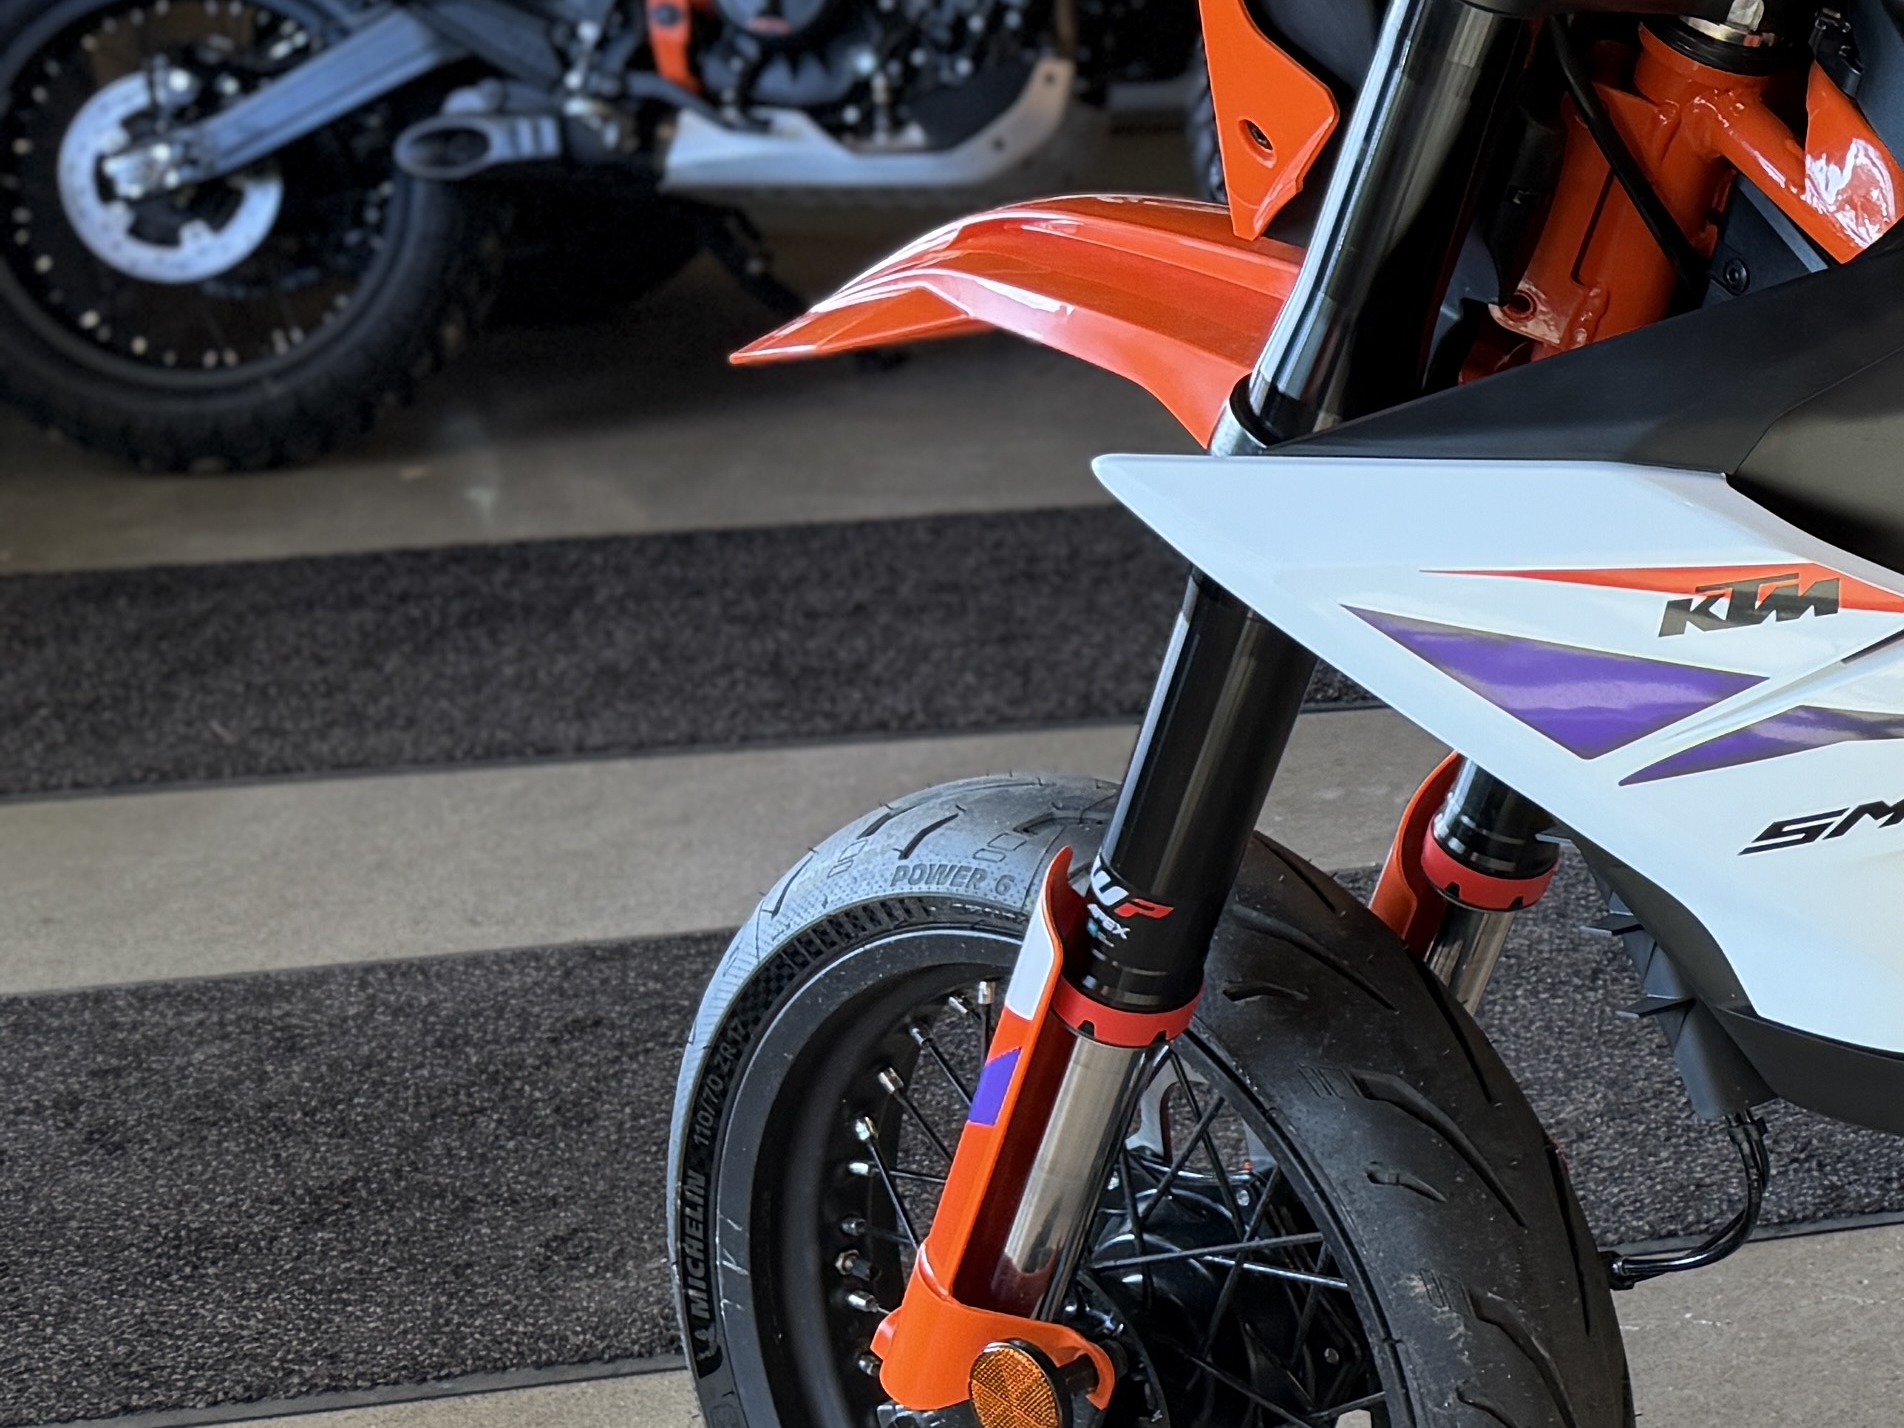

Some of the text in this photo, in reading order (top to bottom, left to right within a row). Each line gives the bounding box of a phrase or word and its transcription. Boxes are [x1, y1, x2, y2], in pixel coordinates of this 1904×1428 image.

[1658, 572, 1840, 637] KTM
[890, 863, 1016, 896] POWER 6
[694, 1074, 725, 1146] 110/70
[683, 1172, 712, 1316] MICHELIN
